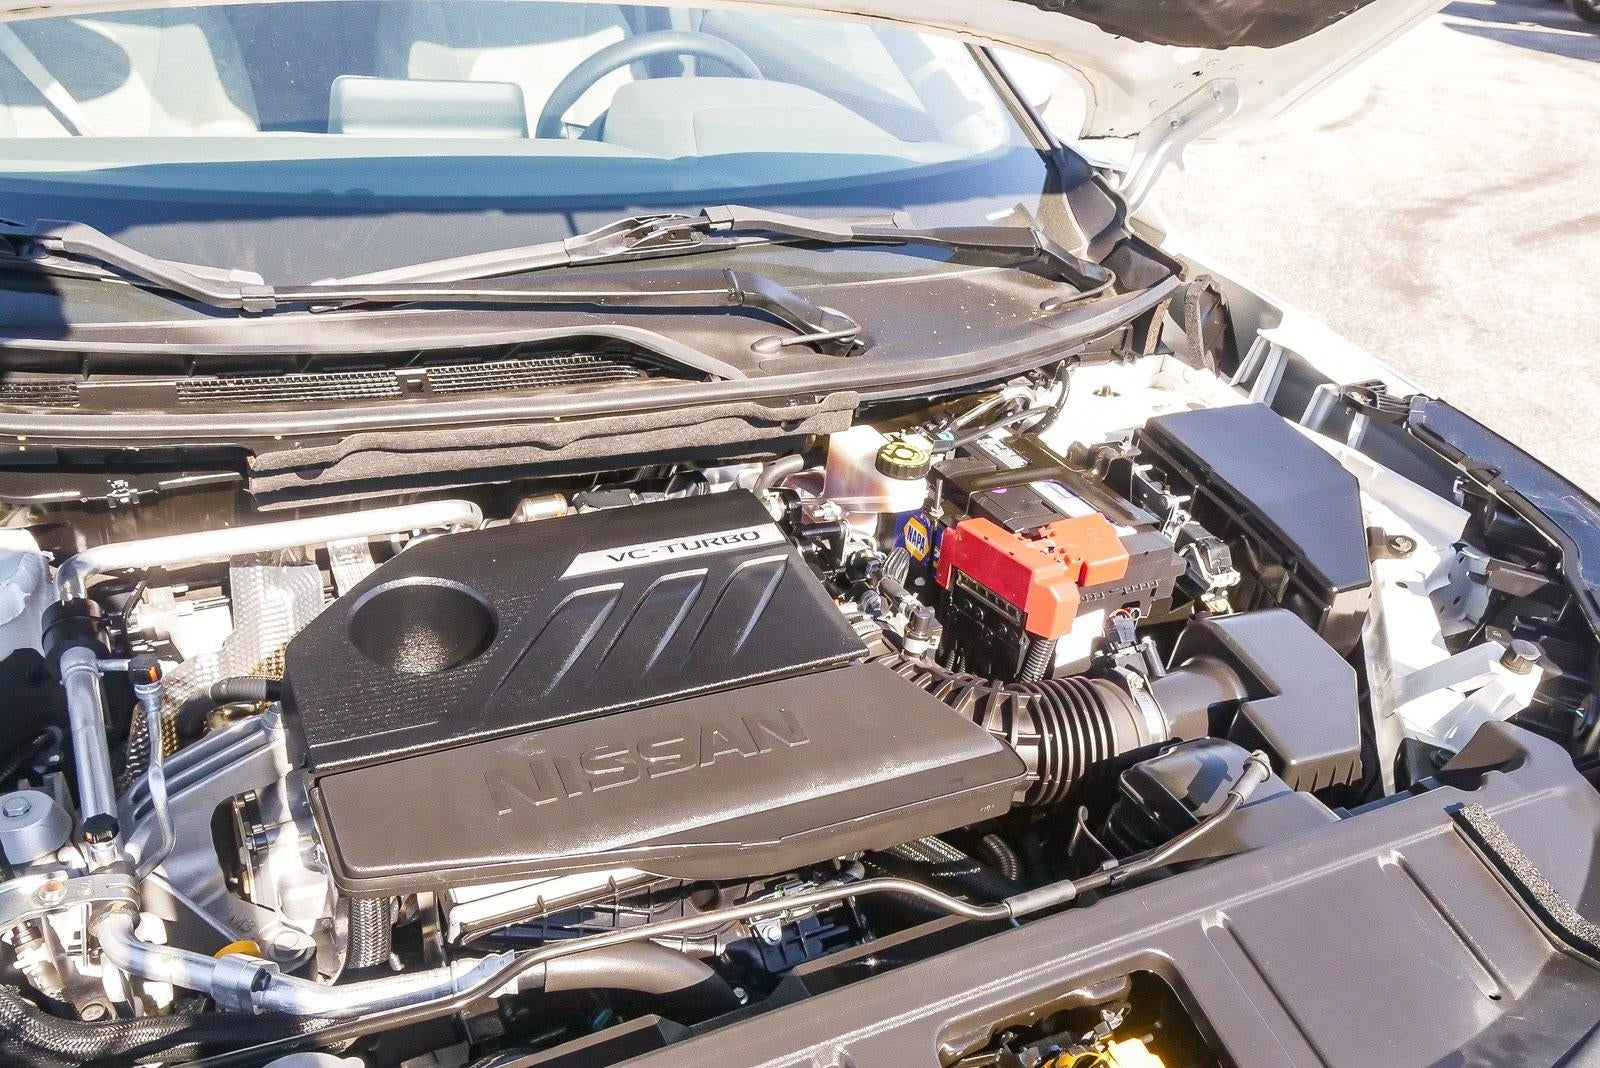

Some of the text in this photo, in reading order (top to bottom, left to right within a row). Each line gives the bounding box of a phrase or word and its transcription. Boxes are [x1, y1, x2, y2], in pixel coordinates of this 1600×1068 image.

[606, 531, 761, 562] VC-TURBO
[906, 525, 926, 554] NAPA
[484, 709, 810, 815] NISSAN
